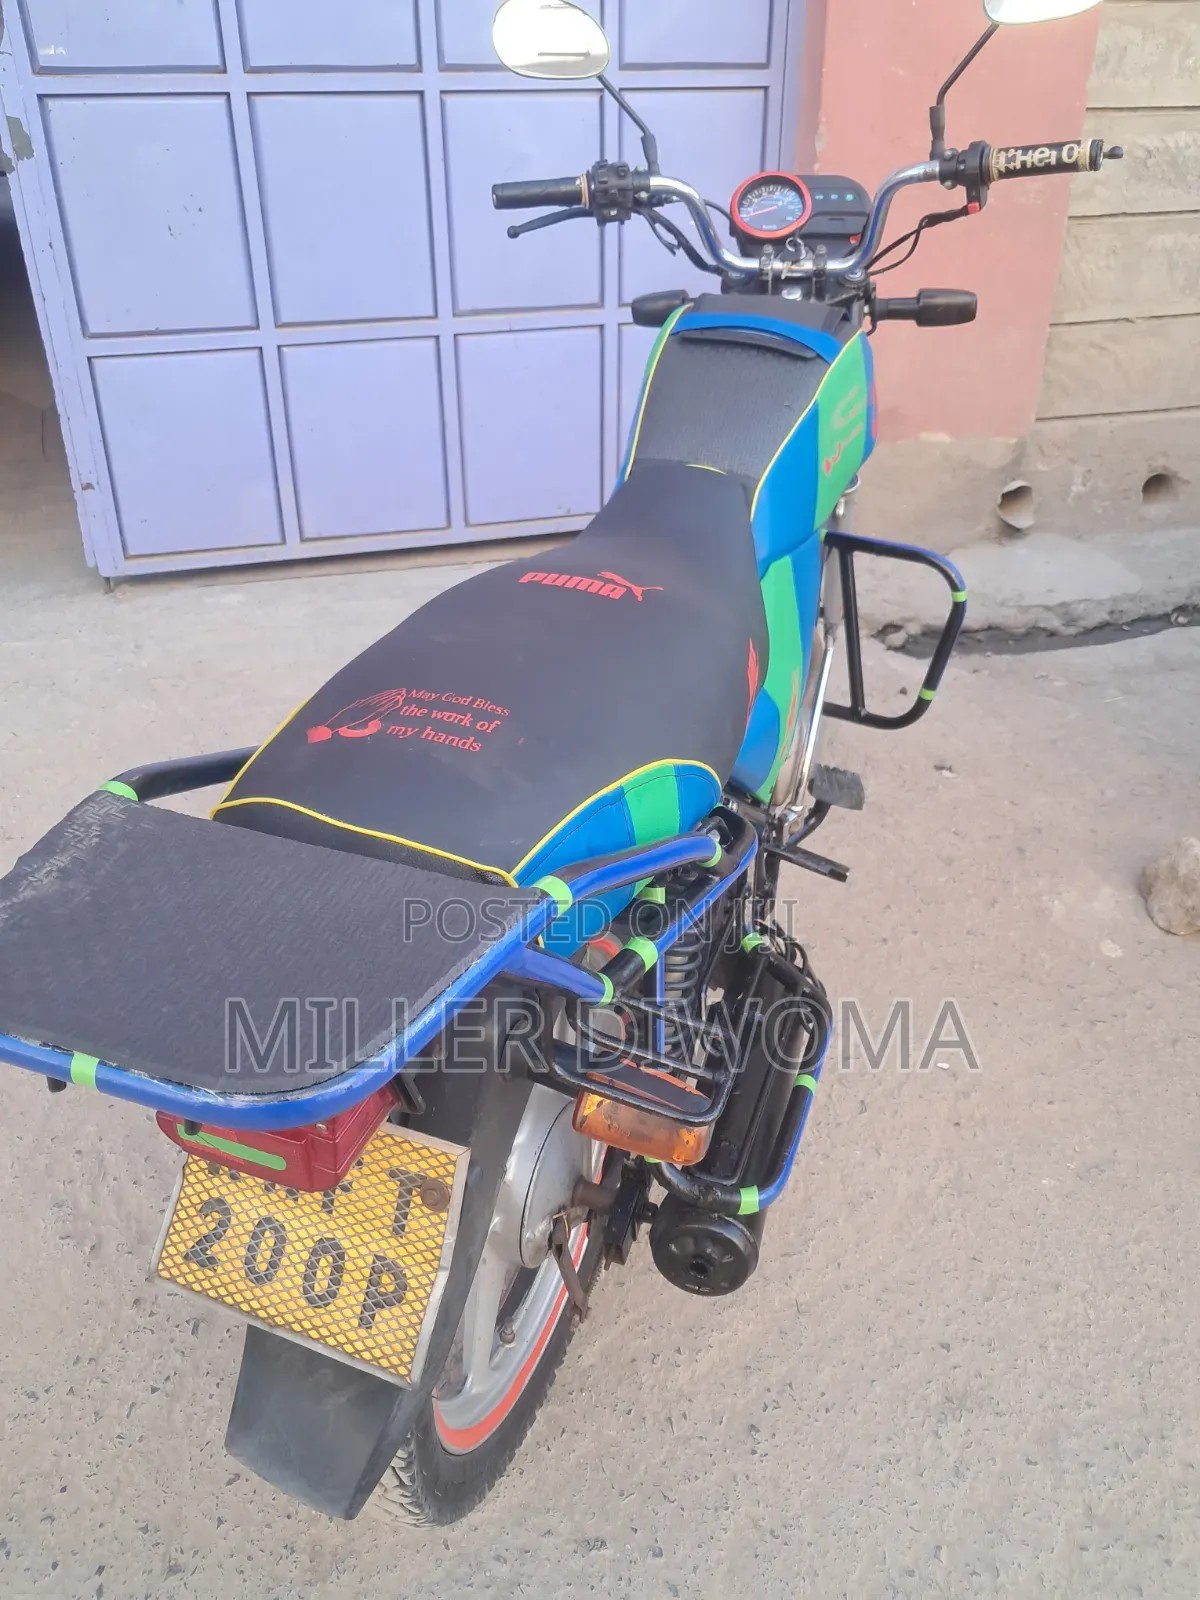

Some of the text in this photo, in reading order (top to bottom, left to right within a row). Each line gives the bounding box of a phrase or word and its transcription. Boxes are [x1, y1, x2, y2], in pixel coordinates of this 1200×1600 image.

[518, 572, 627, 599] PUMA
[408, 688, 510, 716] May God Bless
[400, 704, 502, 734] the work of
[386, 724, 482, 751] my hands
[184, 1198, 408, 1330] 200P
